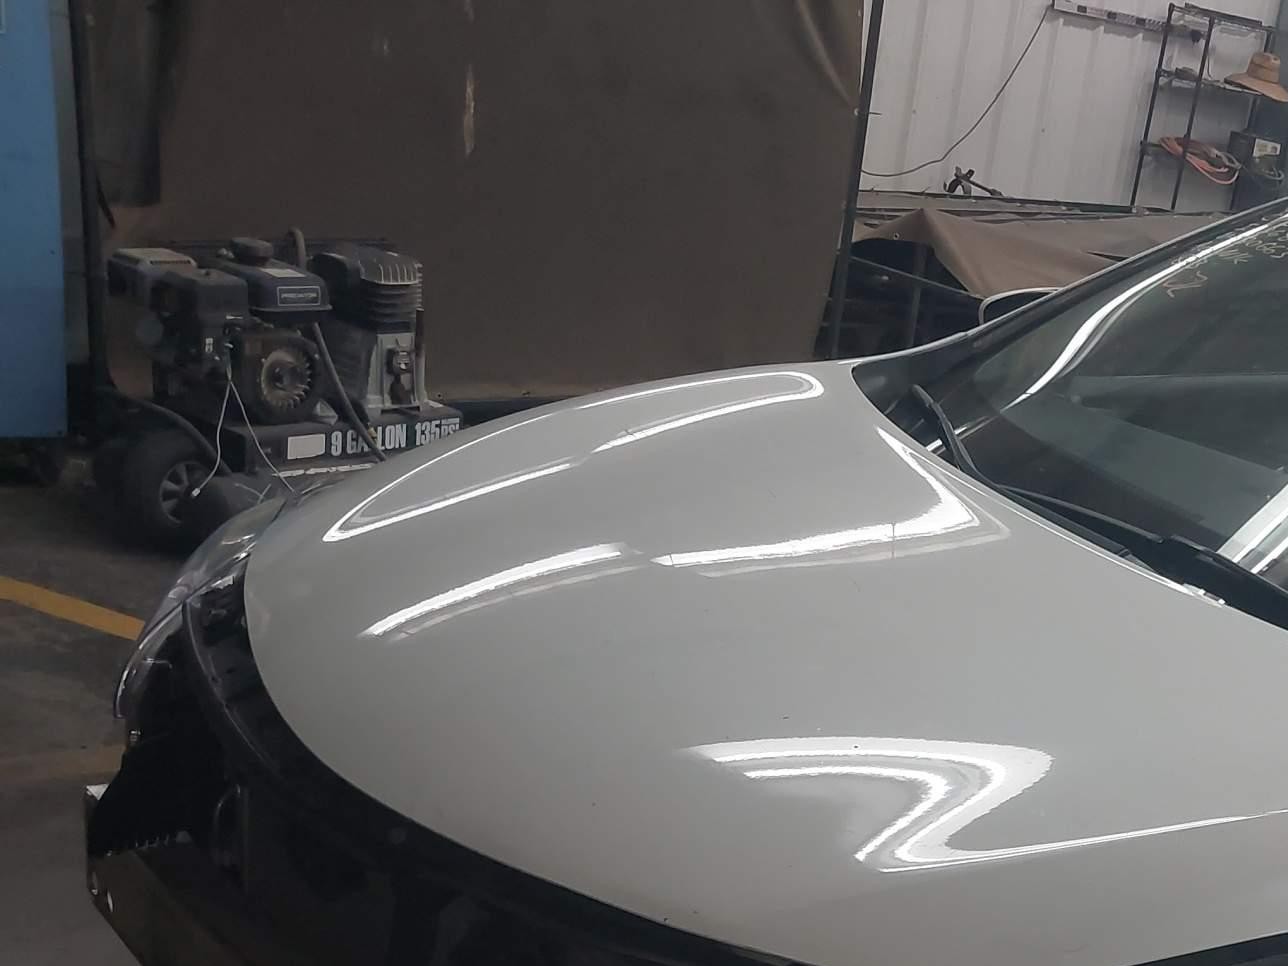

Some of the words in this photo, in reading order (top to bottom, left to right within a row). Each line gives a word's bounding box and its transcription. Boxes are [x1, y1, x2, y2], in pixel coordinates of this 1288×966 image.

[331, 431, 343, 456] 9
[346, 423, 407, 454] GALON
[415, 420, 440, 446] 135
